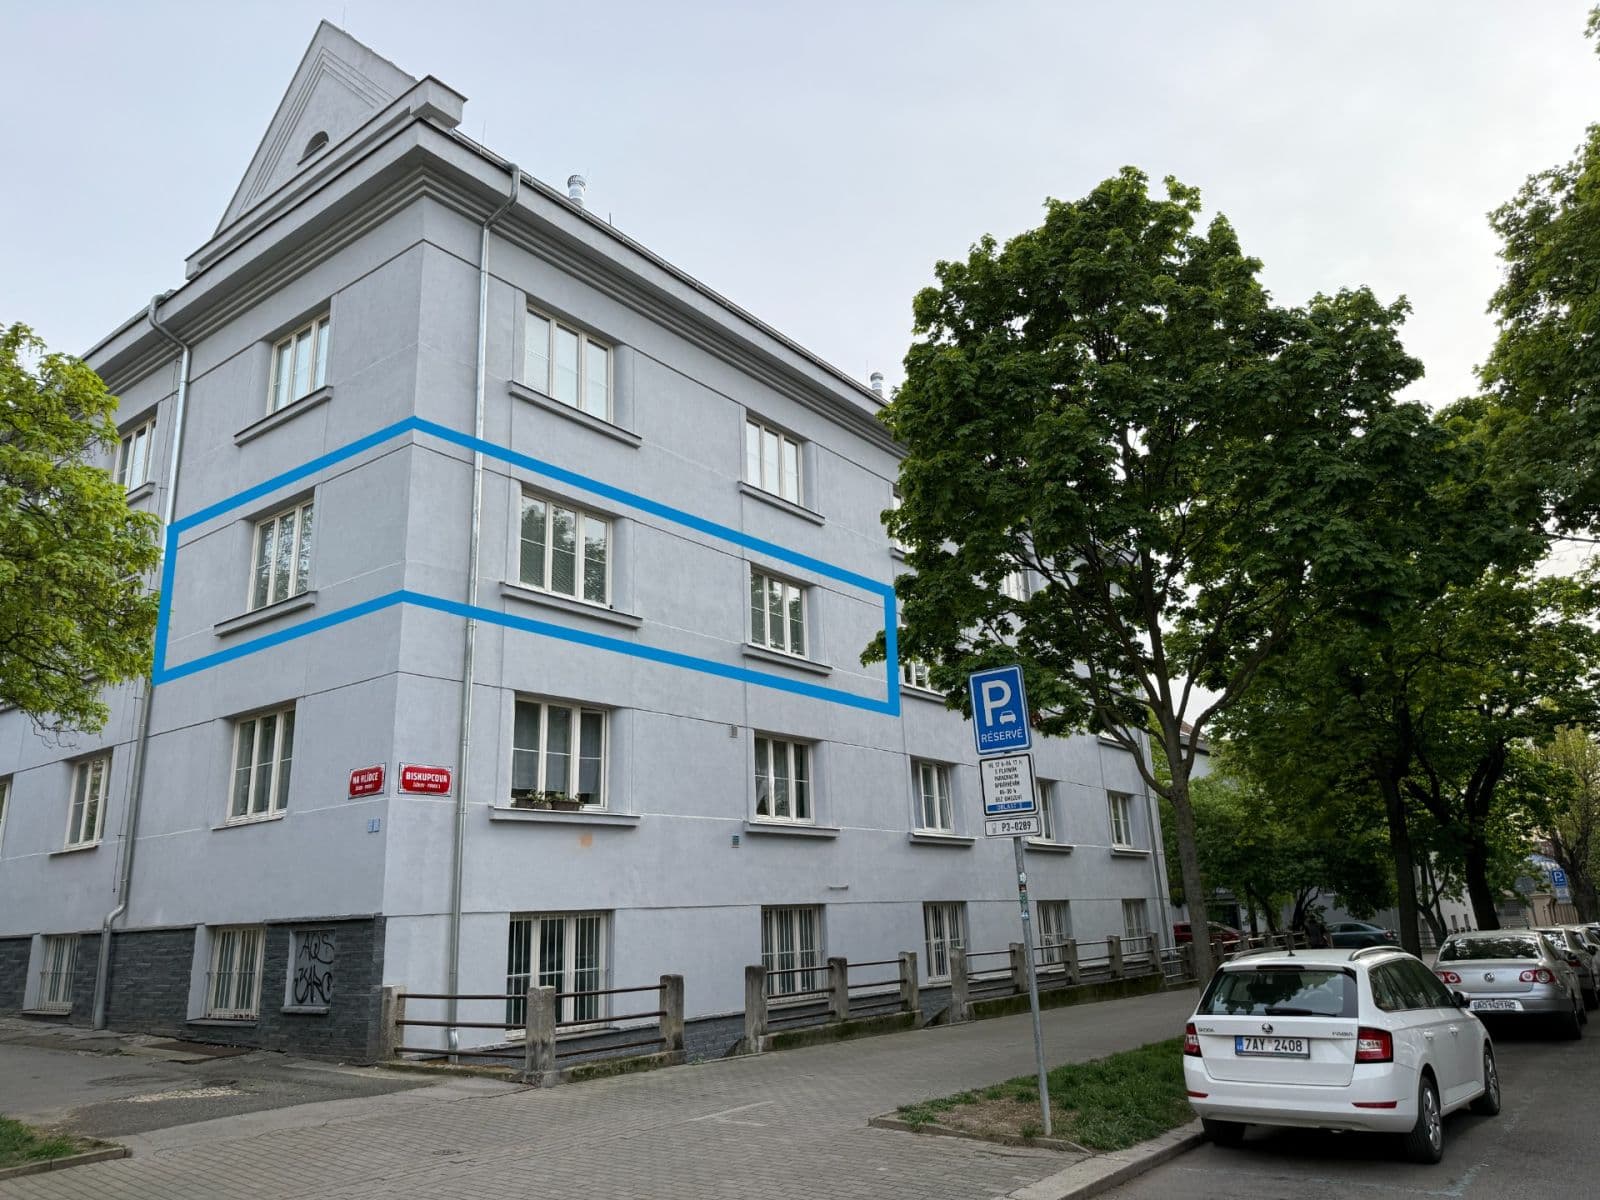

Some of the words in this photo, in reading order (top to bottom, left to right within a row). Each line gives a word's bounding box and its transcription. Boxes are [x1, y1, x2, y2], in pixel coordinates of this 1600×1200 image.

[982, 680, 1011, 727] P
[981, 726, 1023, 743] RÉSERVÉ
[406, 772, 448, 783] BISKUPCOVA
[1001, 820, 1031, 831] P3-0289
[1245, 1038, 1265, 1051] 7AY
[1274, 1039, 1303, 1052] 2408
